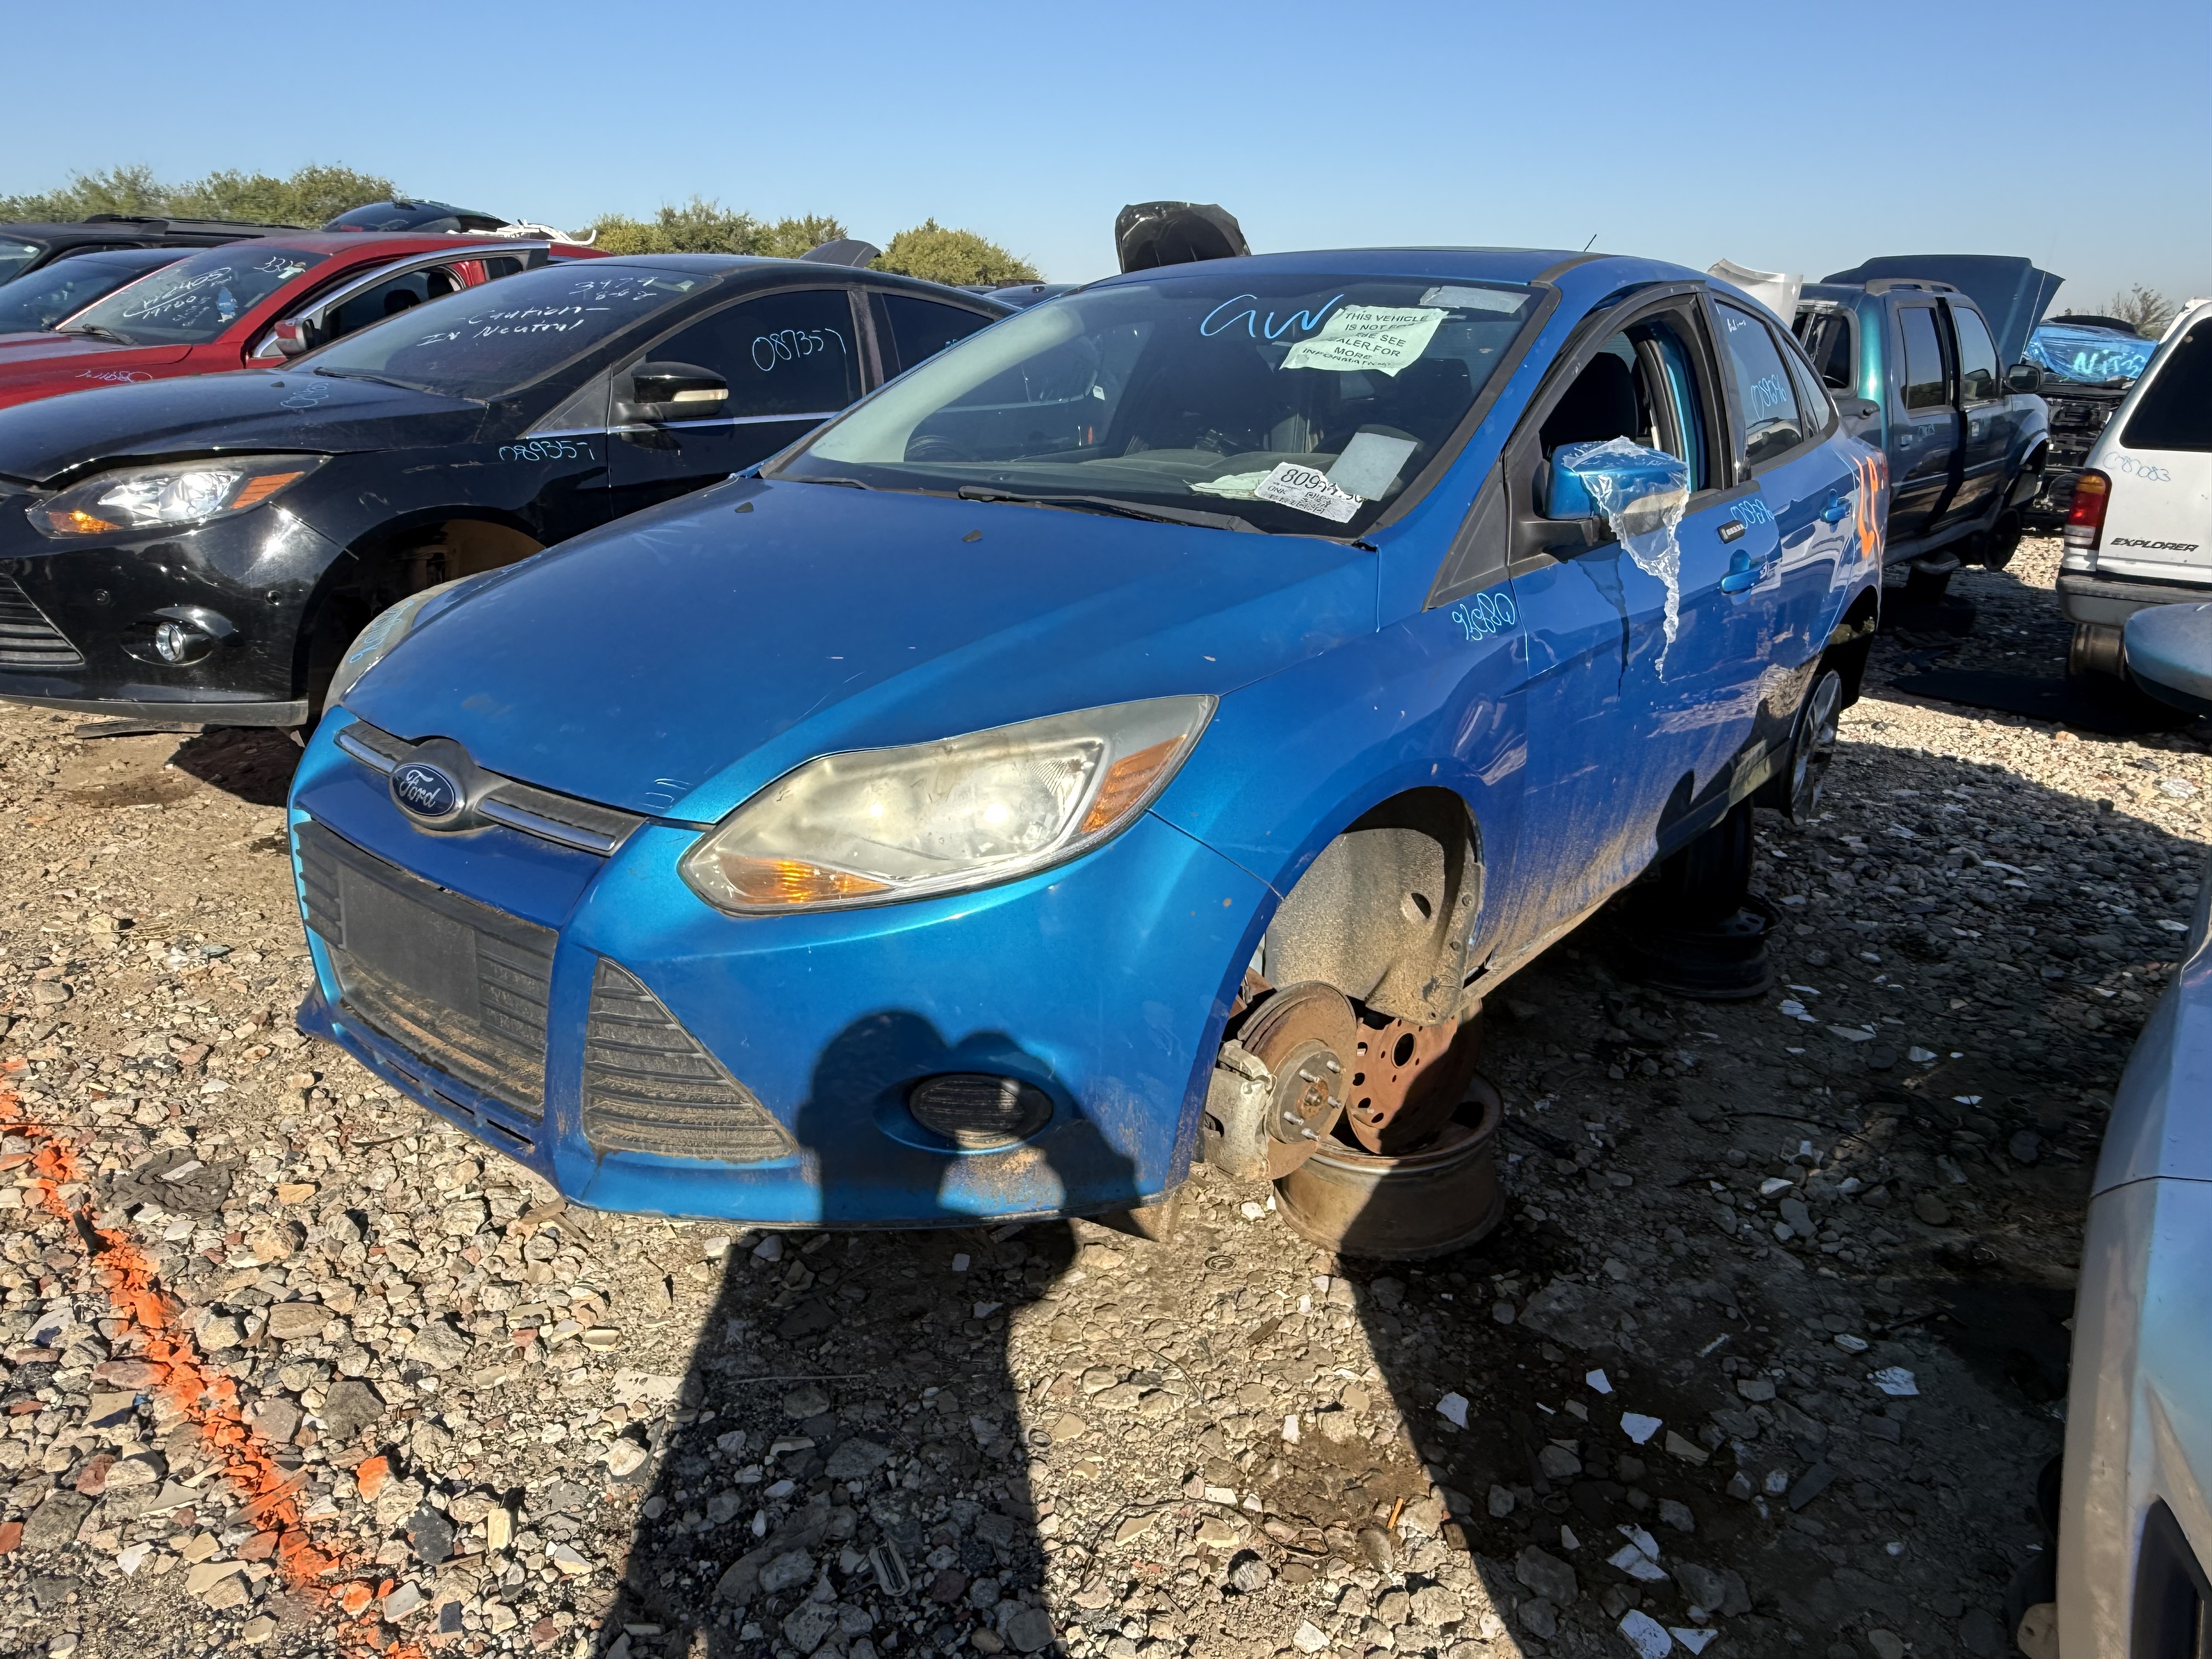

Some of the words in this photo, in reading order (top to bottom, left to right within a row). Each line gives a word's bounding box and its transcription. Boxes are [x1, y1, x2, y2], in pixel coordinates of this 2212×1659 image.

[1346, 311, 1372, 320] THIS
[1380, 335, 1406, 347] SEE
[1334, 347, 1372, 359] MORE
[1373, 345, 1401, 357] FOR
[2111, 538, 2199, 552] EXPLORER
[399, 769, 441, 808] Ford
